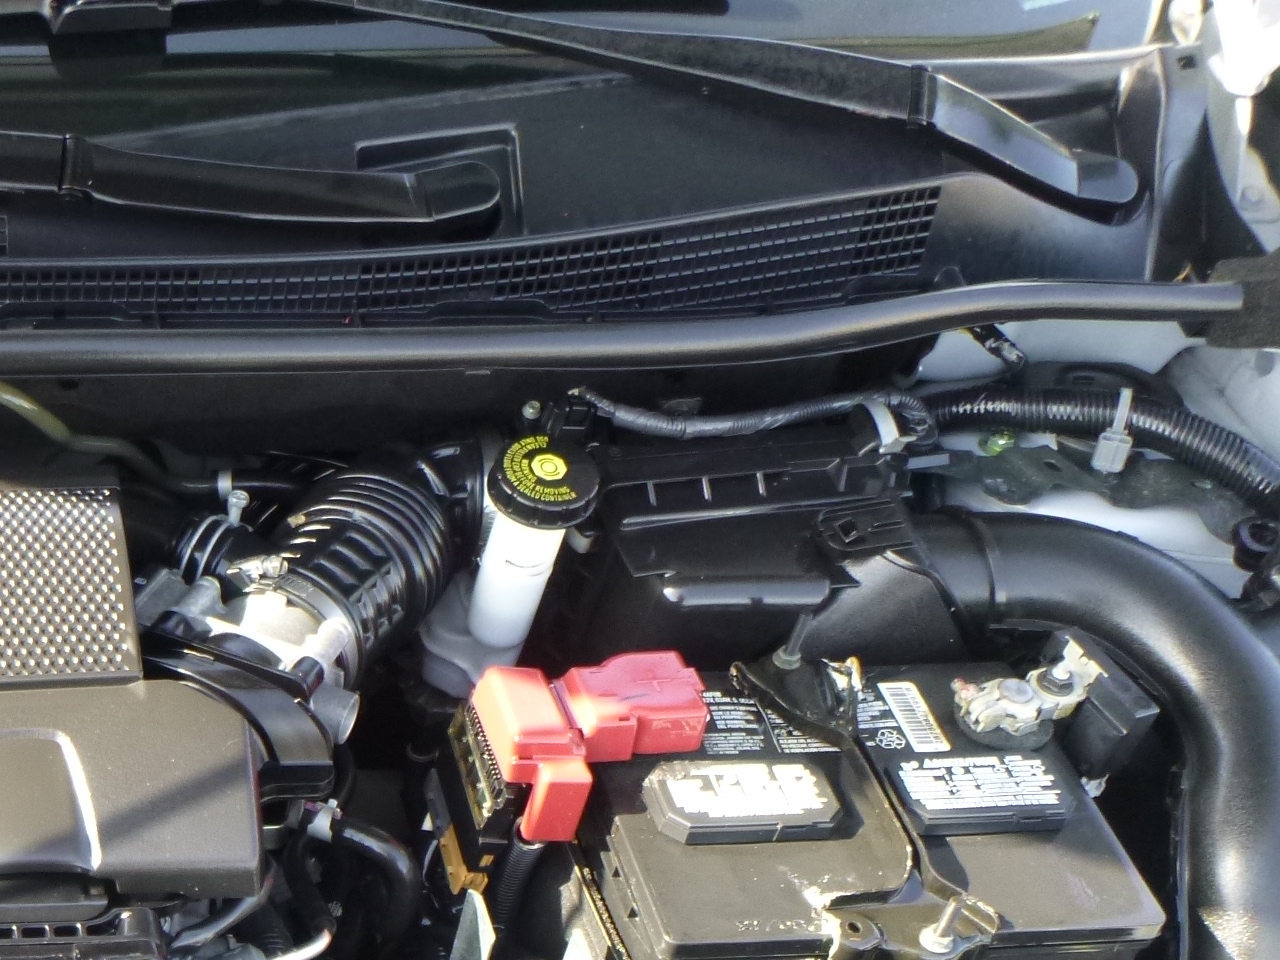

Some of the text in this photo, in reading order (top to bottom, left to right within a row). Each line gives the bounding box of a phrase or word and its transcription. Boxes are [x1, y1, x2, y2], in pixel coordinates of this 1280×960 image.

[514, 471, 536, 489] BEFORE
[535, 485, 570, 495] REMOVING
[516, 484, 540, 499] SEALED
[540, 491, 578, 501] CONTAINER
